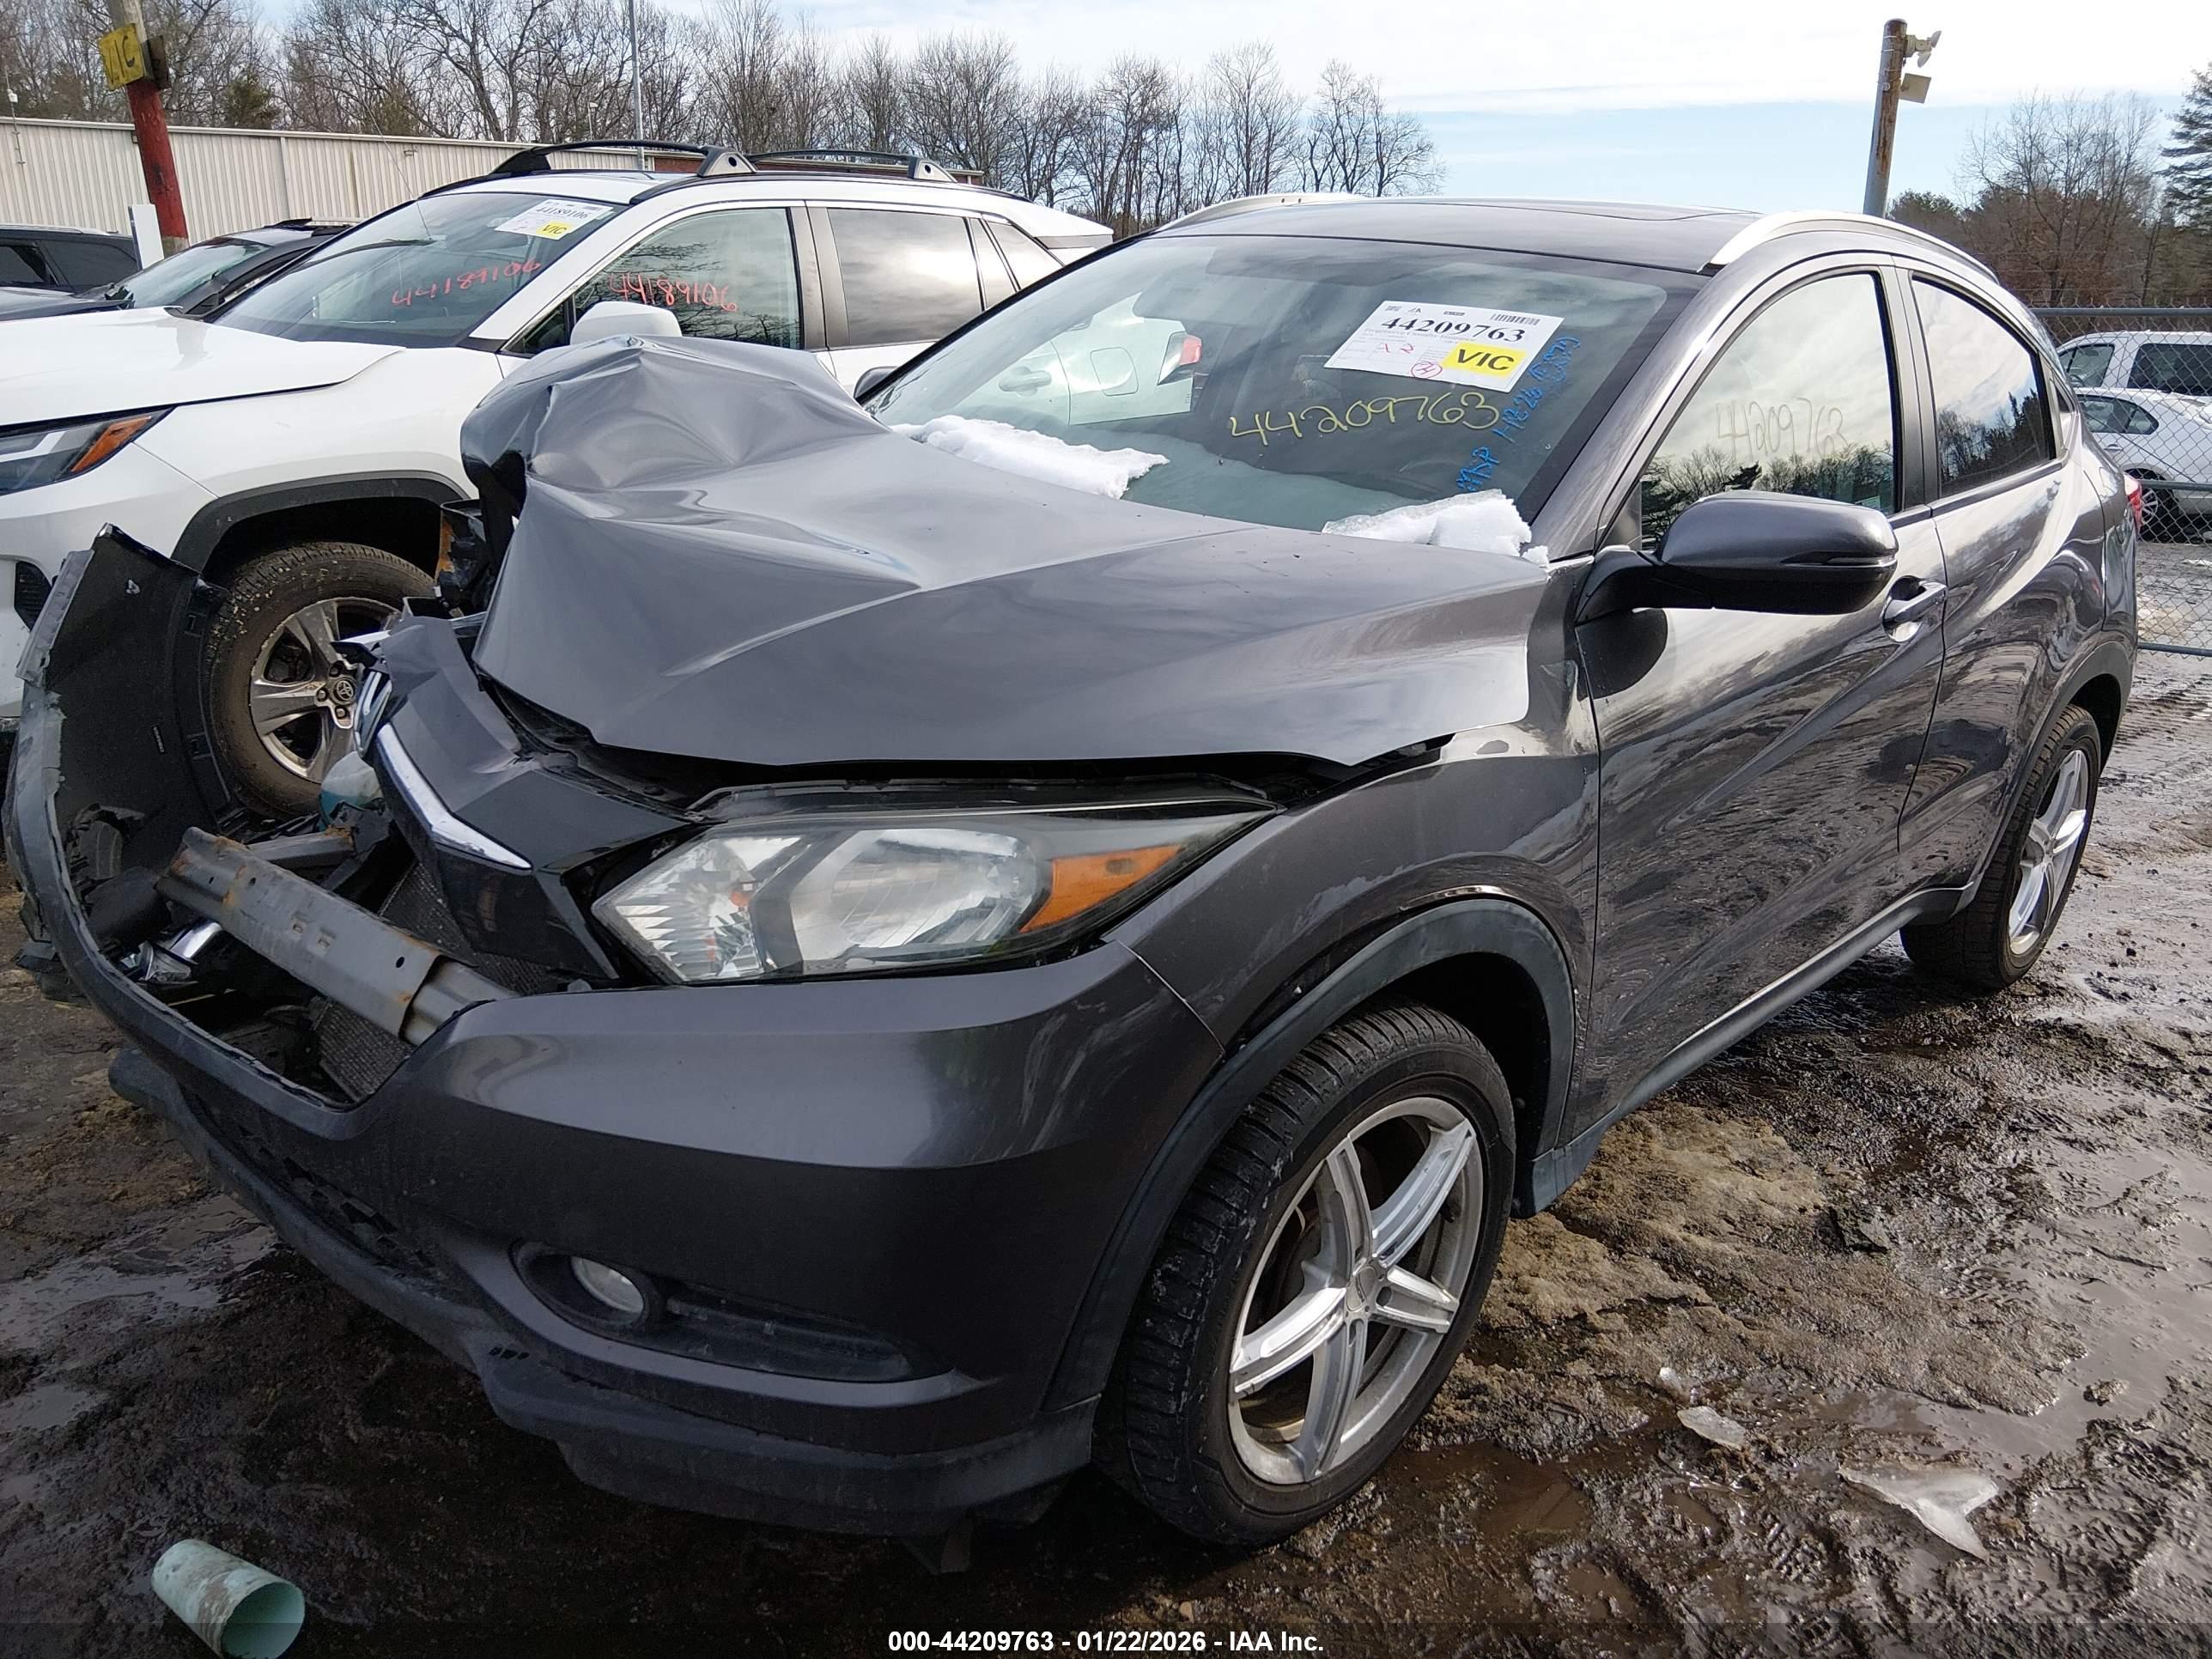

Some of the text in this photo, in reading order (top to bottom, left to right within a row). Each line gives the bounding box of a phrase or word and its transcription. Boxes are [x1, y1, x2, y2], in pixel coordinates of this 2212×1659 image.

[542, 224, 568, 234] VIC
[392, 259, 541, 306] 44189106
[608, 272, 738, 313] 44189106
[1382, 317, 1525, 343] 44209763
[1457, 349, 1515, 371] VIC
[1230, 392, 1499, 446] 44209763
